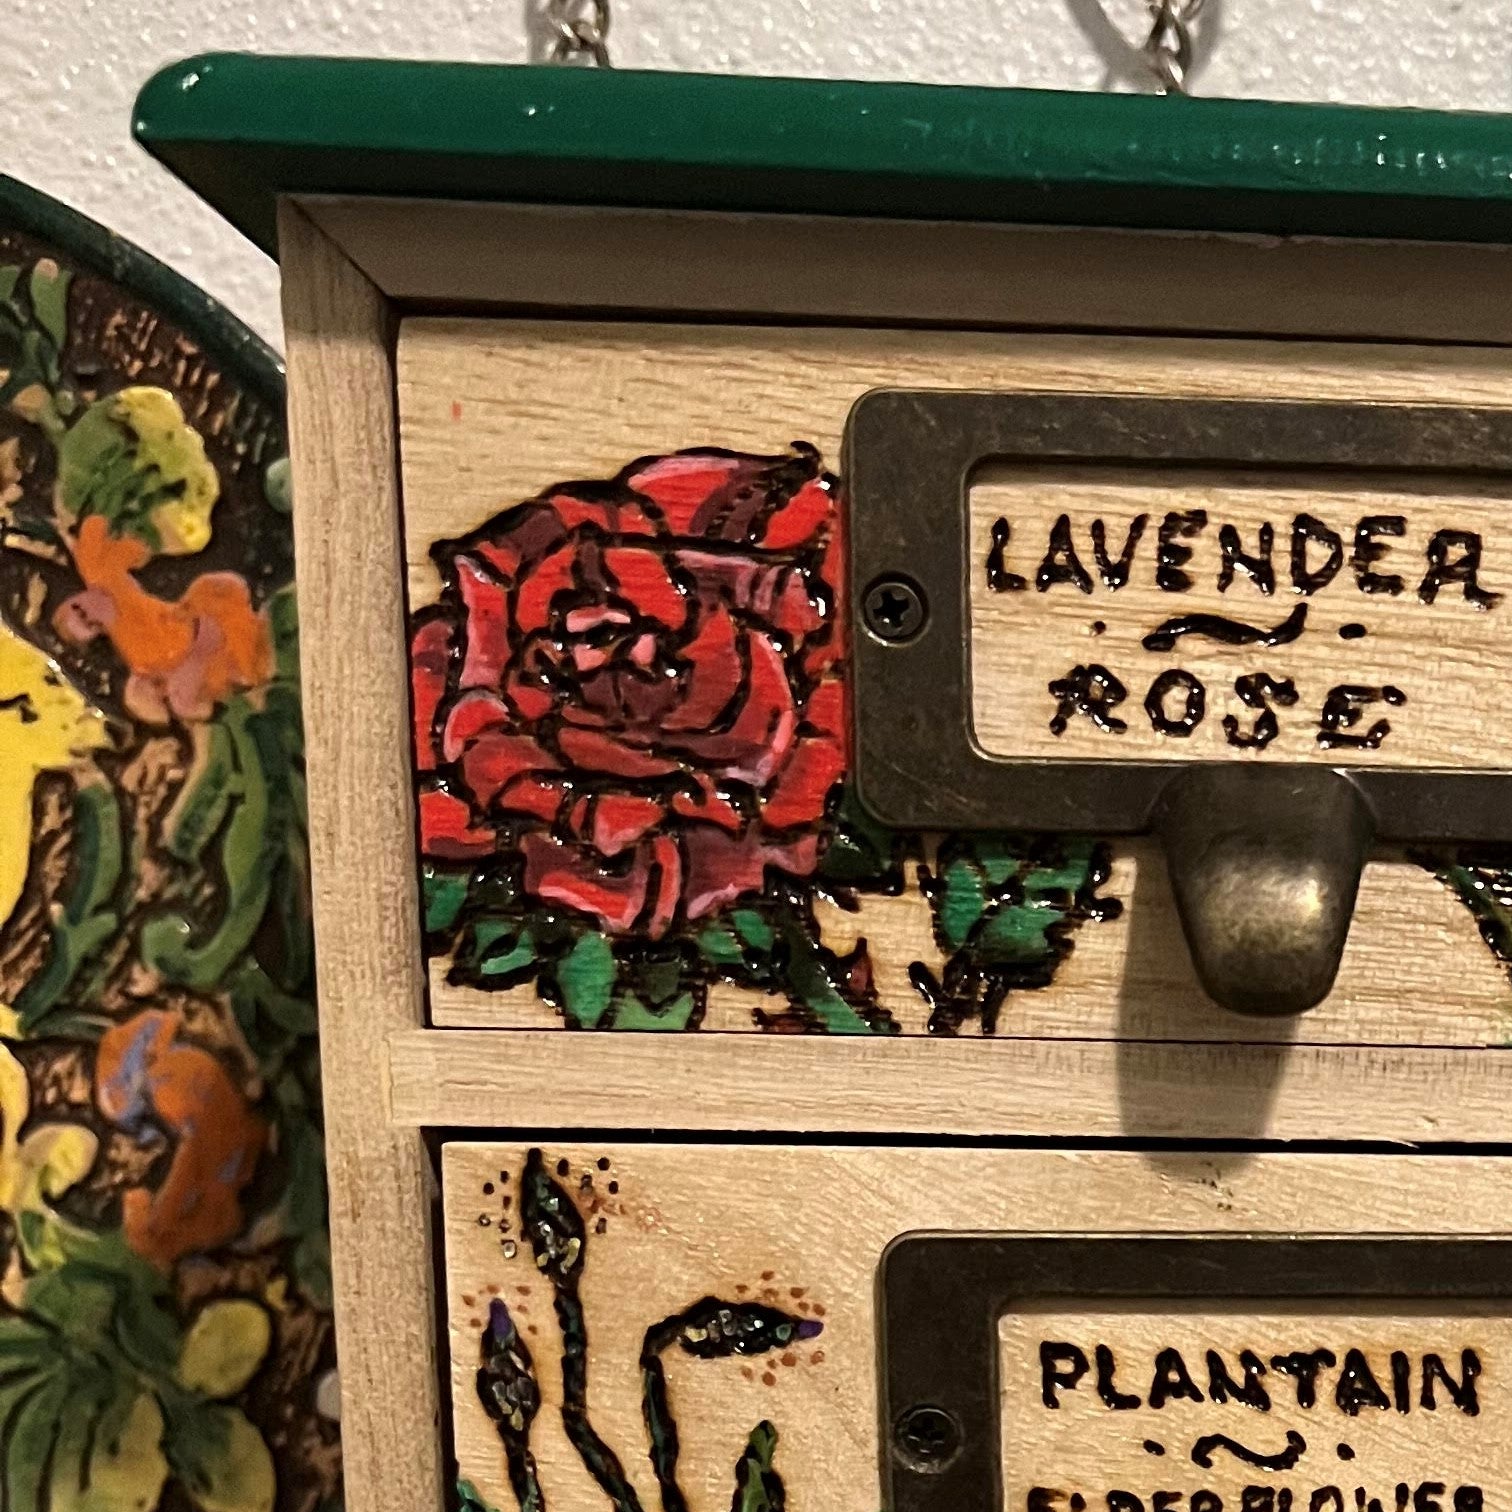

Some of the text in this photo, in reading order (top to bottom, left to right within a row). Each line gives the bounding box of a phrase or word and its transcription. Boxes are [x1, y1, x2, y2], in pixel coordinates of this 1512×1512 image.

[986, 509, 1505, 610] LAVENDER
[1049, 664, 1406, 749] ROSE
[1039, 1341, 1481, 1416] PLANTAIN
